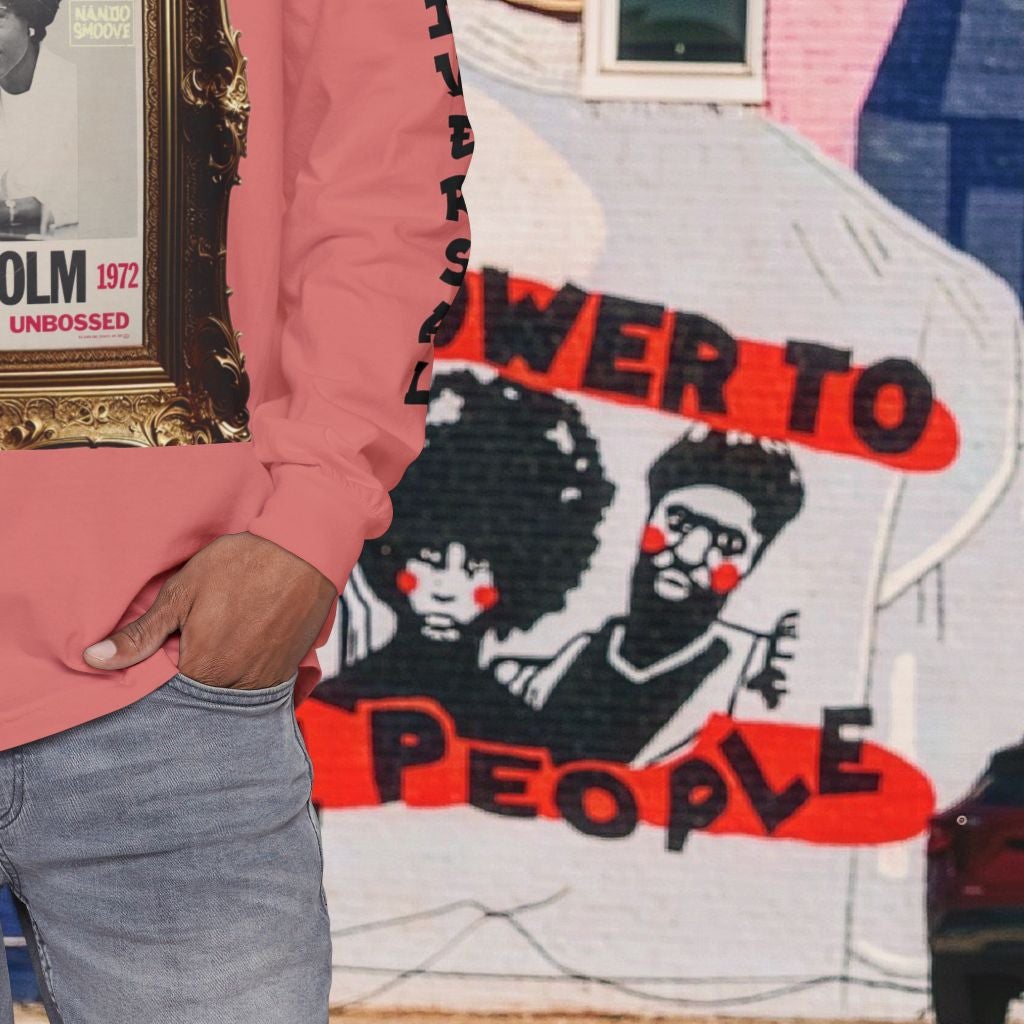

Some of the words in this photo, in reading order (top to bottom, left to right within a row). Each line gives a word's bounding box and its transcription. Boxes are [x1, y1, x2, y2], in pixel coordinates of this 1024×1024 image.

[74, 4, 131, 23] NANDO
[72, 21, 131, 40] SMOOVE
[96, 261, 140, 290] 1972
[9, 311, 131, 334] UNBOSSED
[785, 339, 934, 455] TO
[371, 707, 883, 853] PEOPLE
